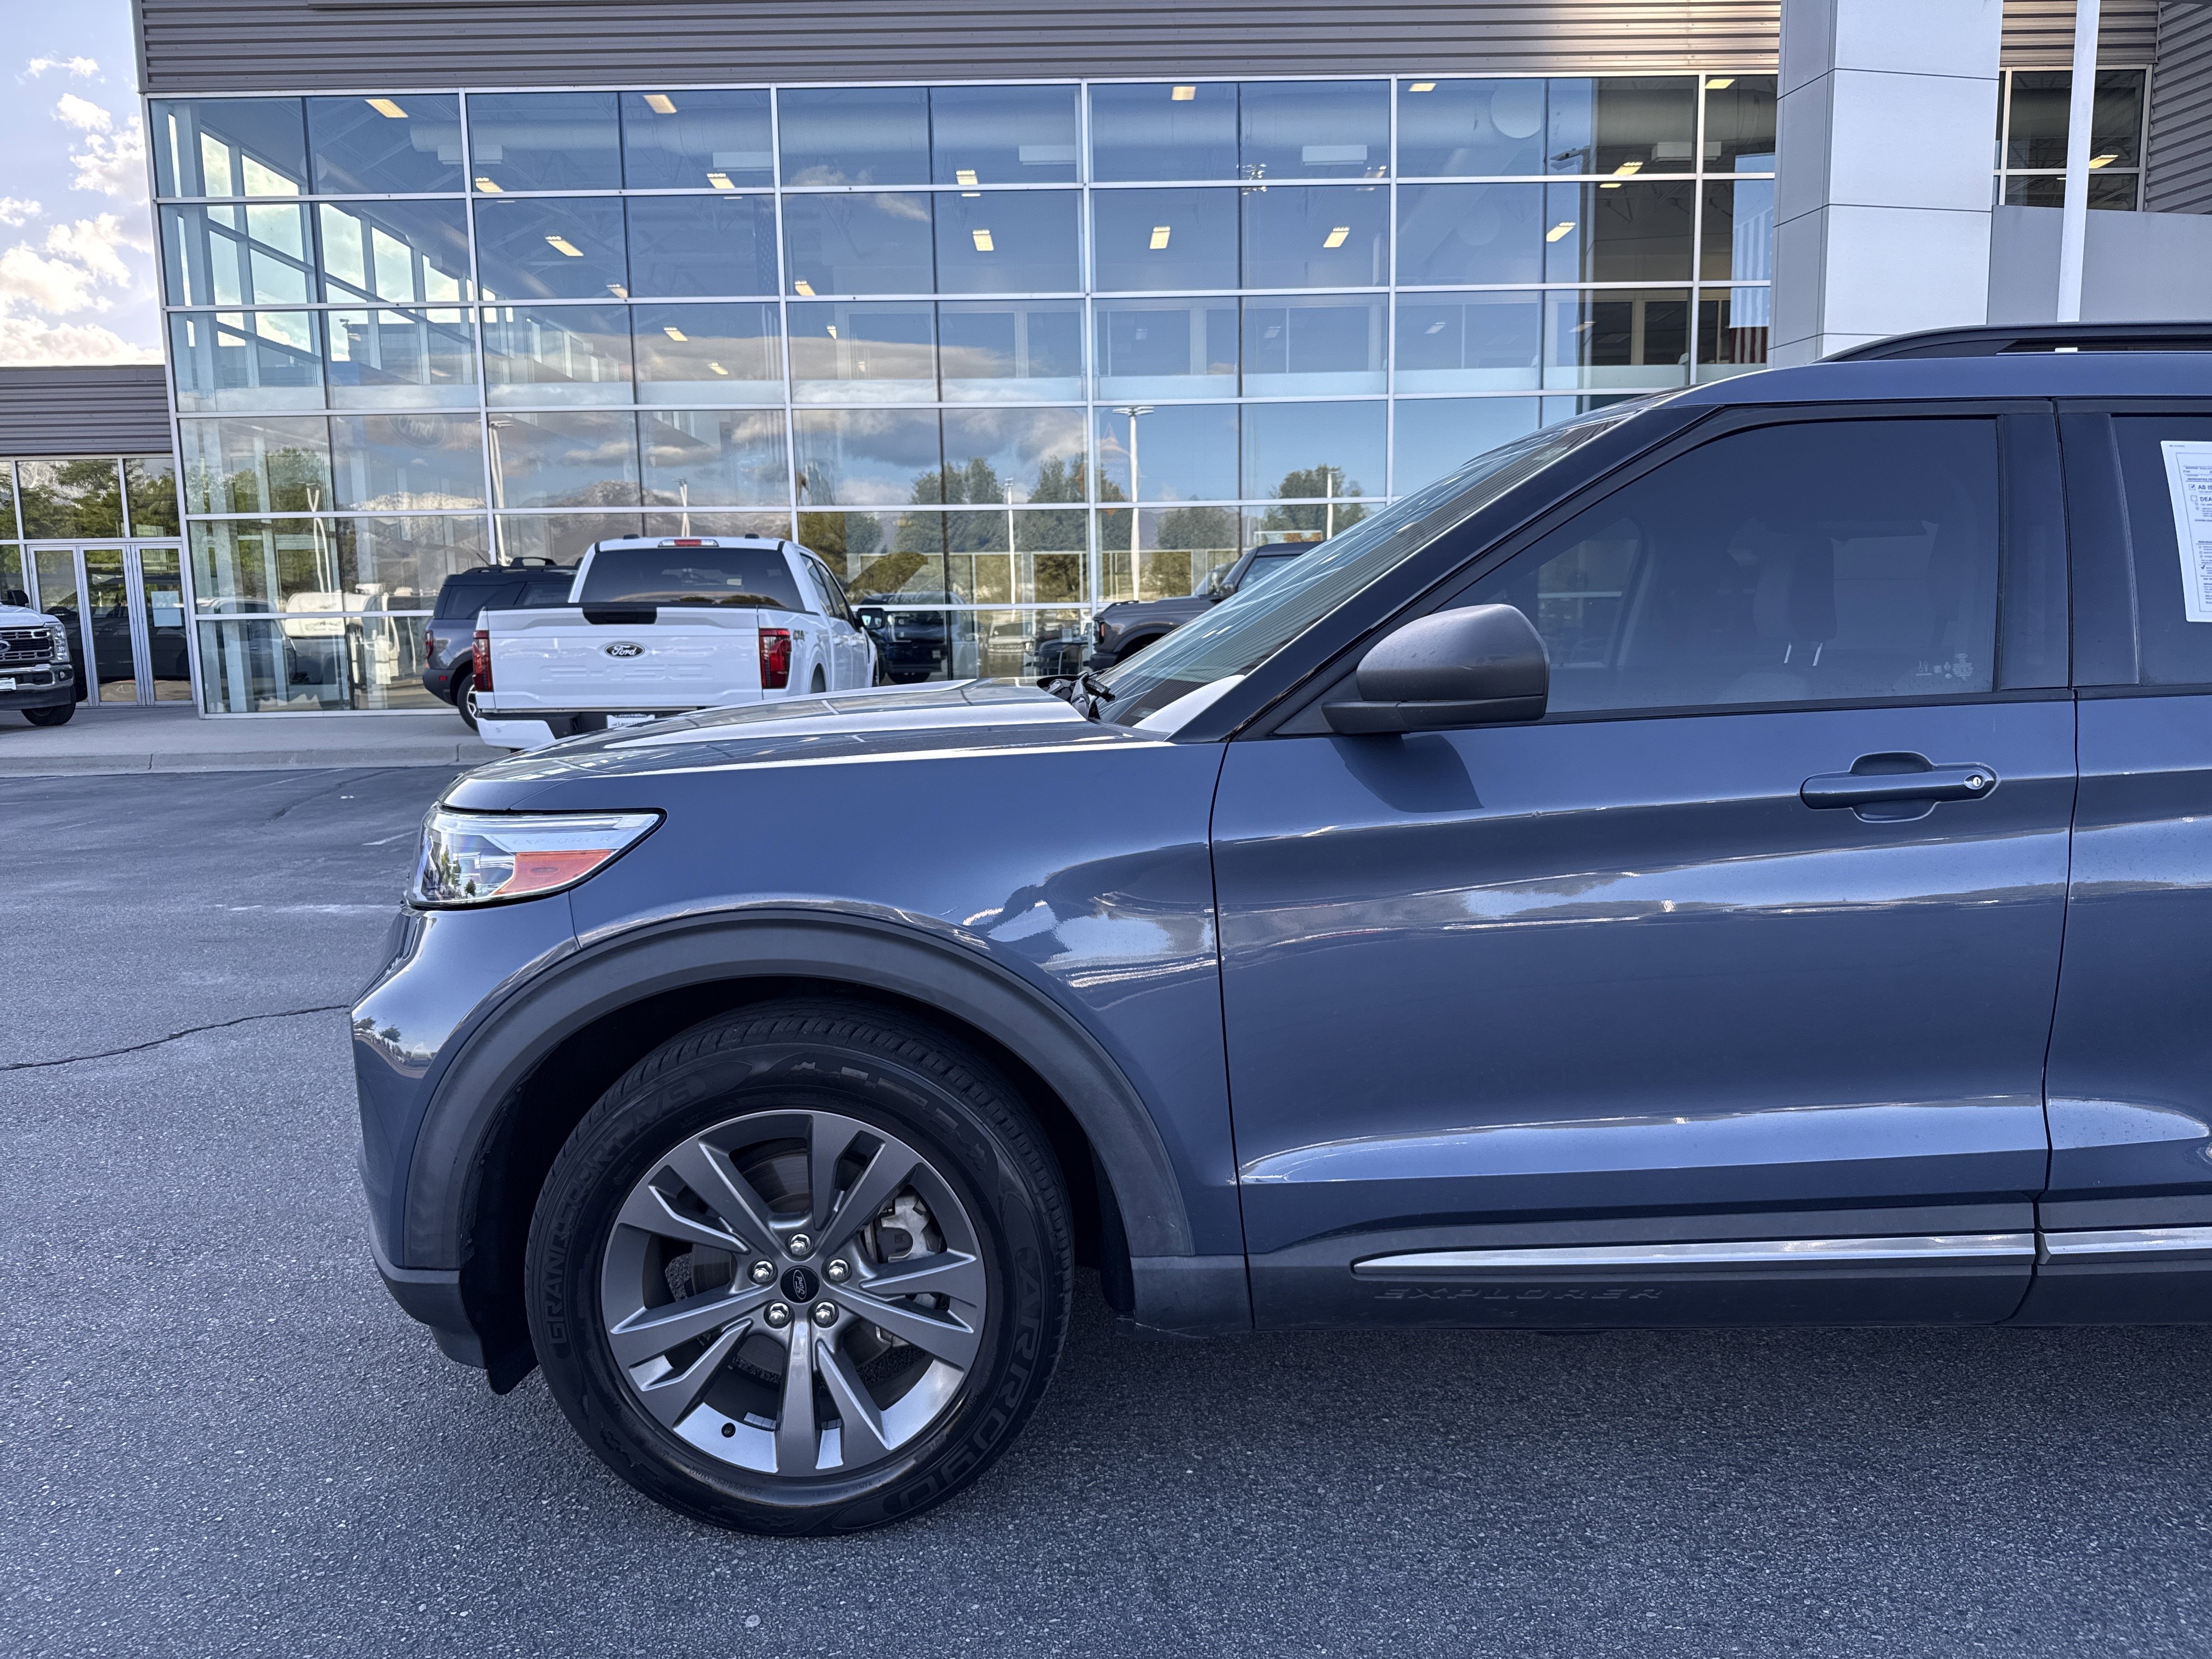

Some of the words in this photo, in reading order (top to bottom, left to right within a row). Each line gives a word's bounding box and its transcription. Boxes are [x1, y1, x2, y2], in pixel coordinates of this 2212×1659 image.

[611, 644, 638, 656] Ford
[512, 836, 612, 845] EXPLORER
[795, 1275, 805, 1295] Ford
[1374, 1288, 1663, 1300] EXPLORER
[898, 1266, 1041, 1510] ARROYO
